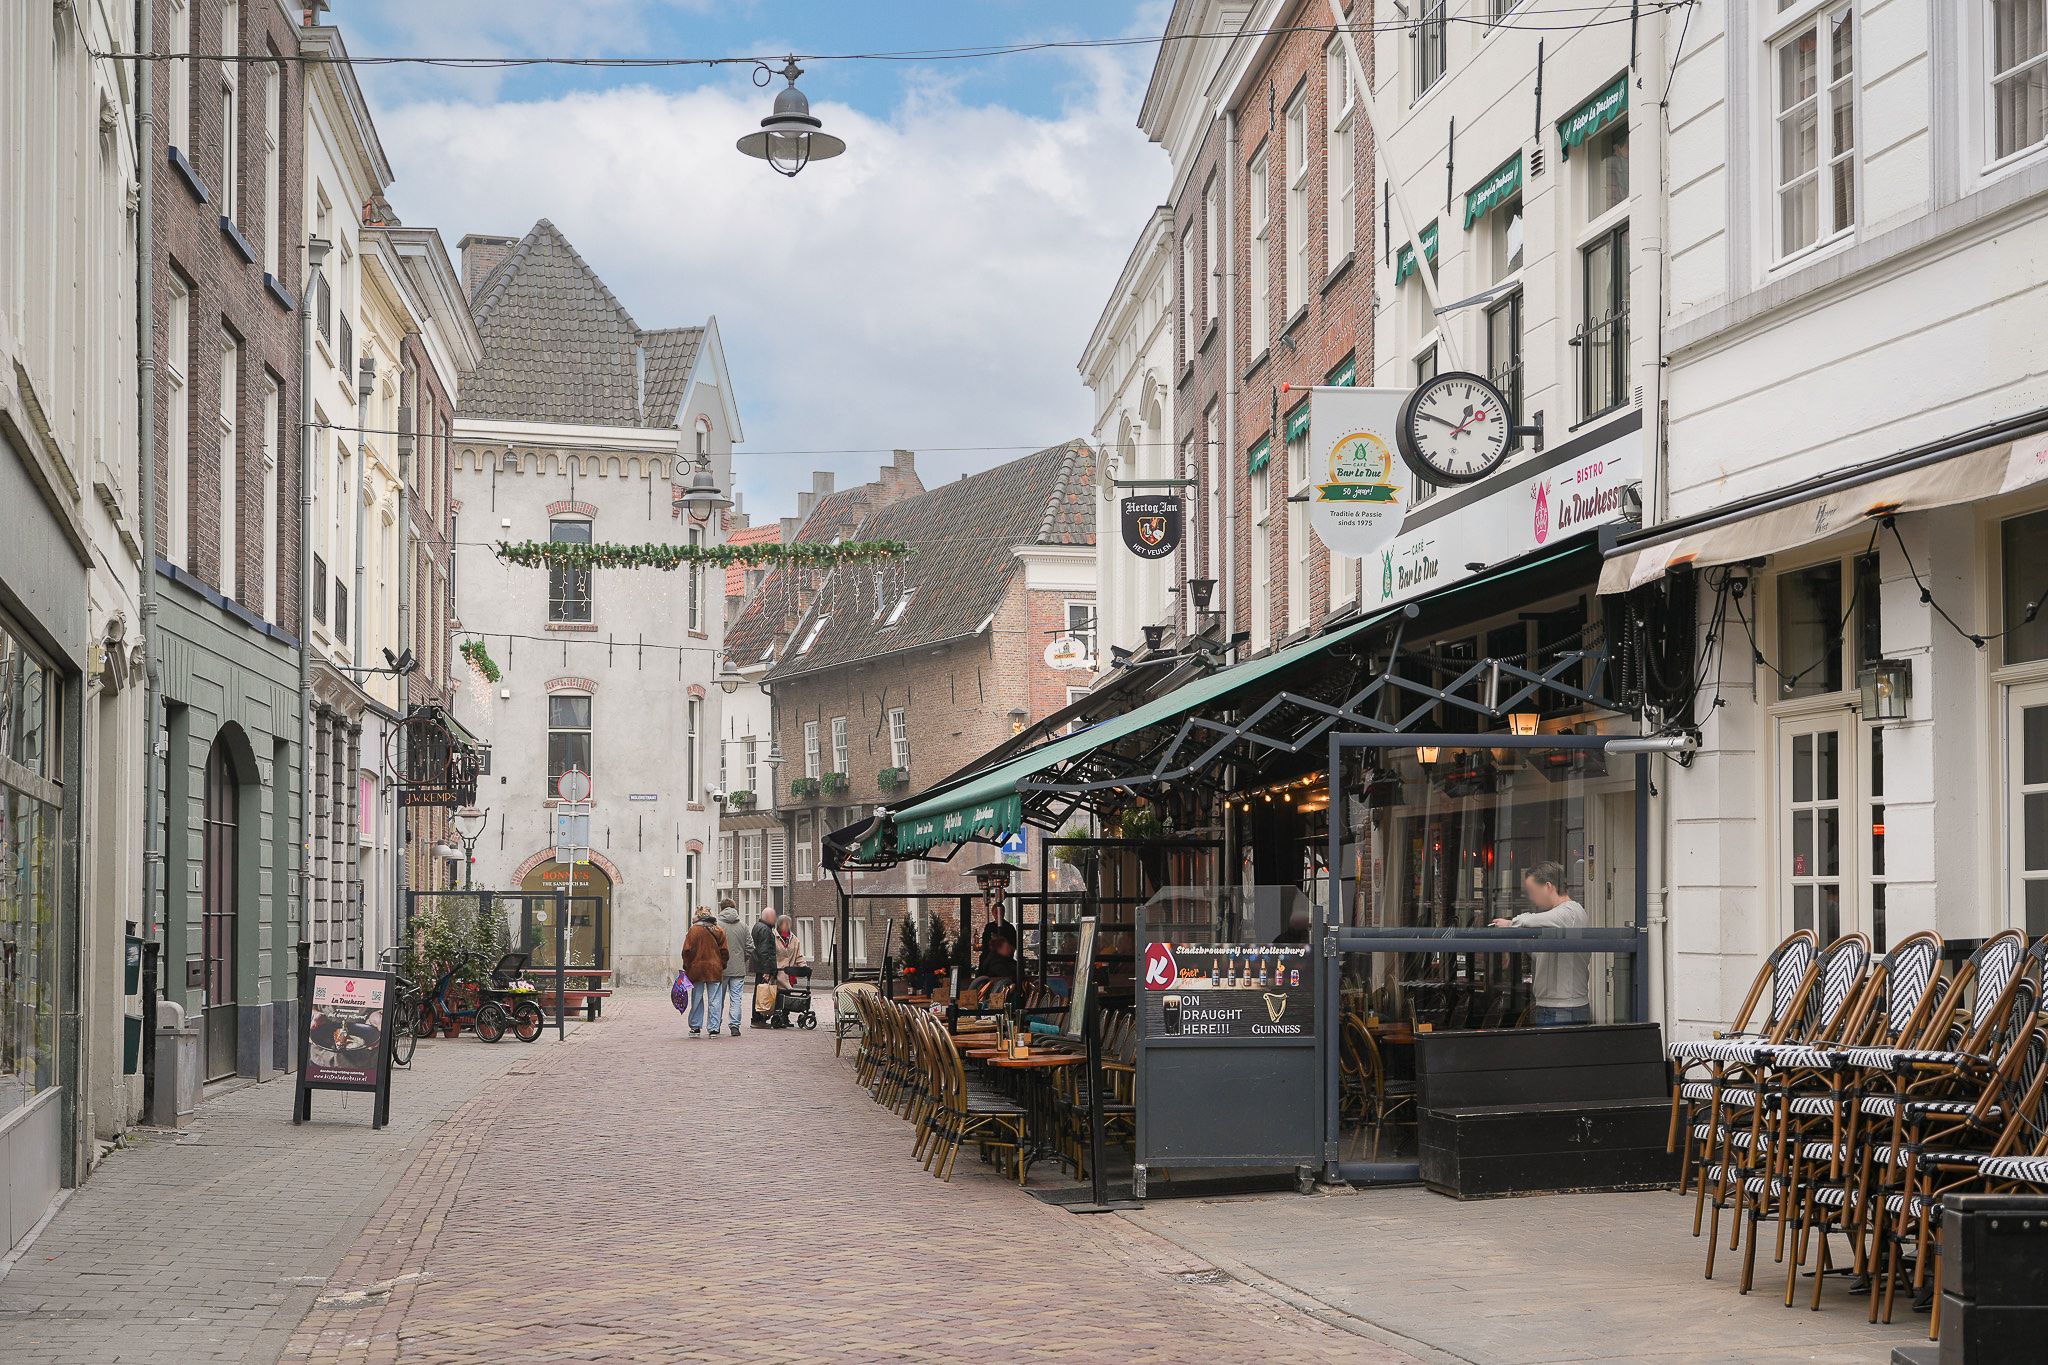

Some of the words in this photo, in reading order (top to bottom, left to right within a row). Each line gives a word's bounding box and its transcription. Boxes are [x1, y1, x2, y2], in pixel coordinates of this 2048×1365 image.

[1336, 467, 1354, 477] Bar
[1354, 468, 1365, 477] Le
[1365, 468, 1382, 478] Duc
[1577, 461, 1604, 484] BISTRO
[1342, 487, 1352, 496] 50
[1125, 502, 1159, 515] Hertog
[1159, 501, 1178, 514] Jan
[1559, 499, 1572, 529] La
[1573, 486, 1620, 523] Duchess
[1361, 511, 1383, 519] Passie
[1357, 519, 1373, 527] 1975
[1132, 543, 1146, 554] HET
[1147, 543, 1172, 556] VEULEN
[1411, 538, 1424, 556] CAFÉ
[1398, 565, 1413, 590] Bar
[1414, 559, 1422, 585] Le
[1423, 555, 1438, 581] Duc
[1242, 947, 1258, 955] van
[1145, 956, 1169, 985] K
[339, 998, 366, 1006] Duchesse
[1182, 995, 1200, 1006] ON
[1183, 1009, 1243, 1020] DRAUGHT
[1183, 1024, 1230, 1035] HERE!!!
[1251, 1023, 1301, 1035] GUINNESS
